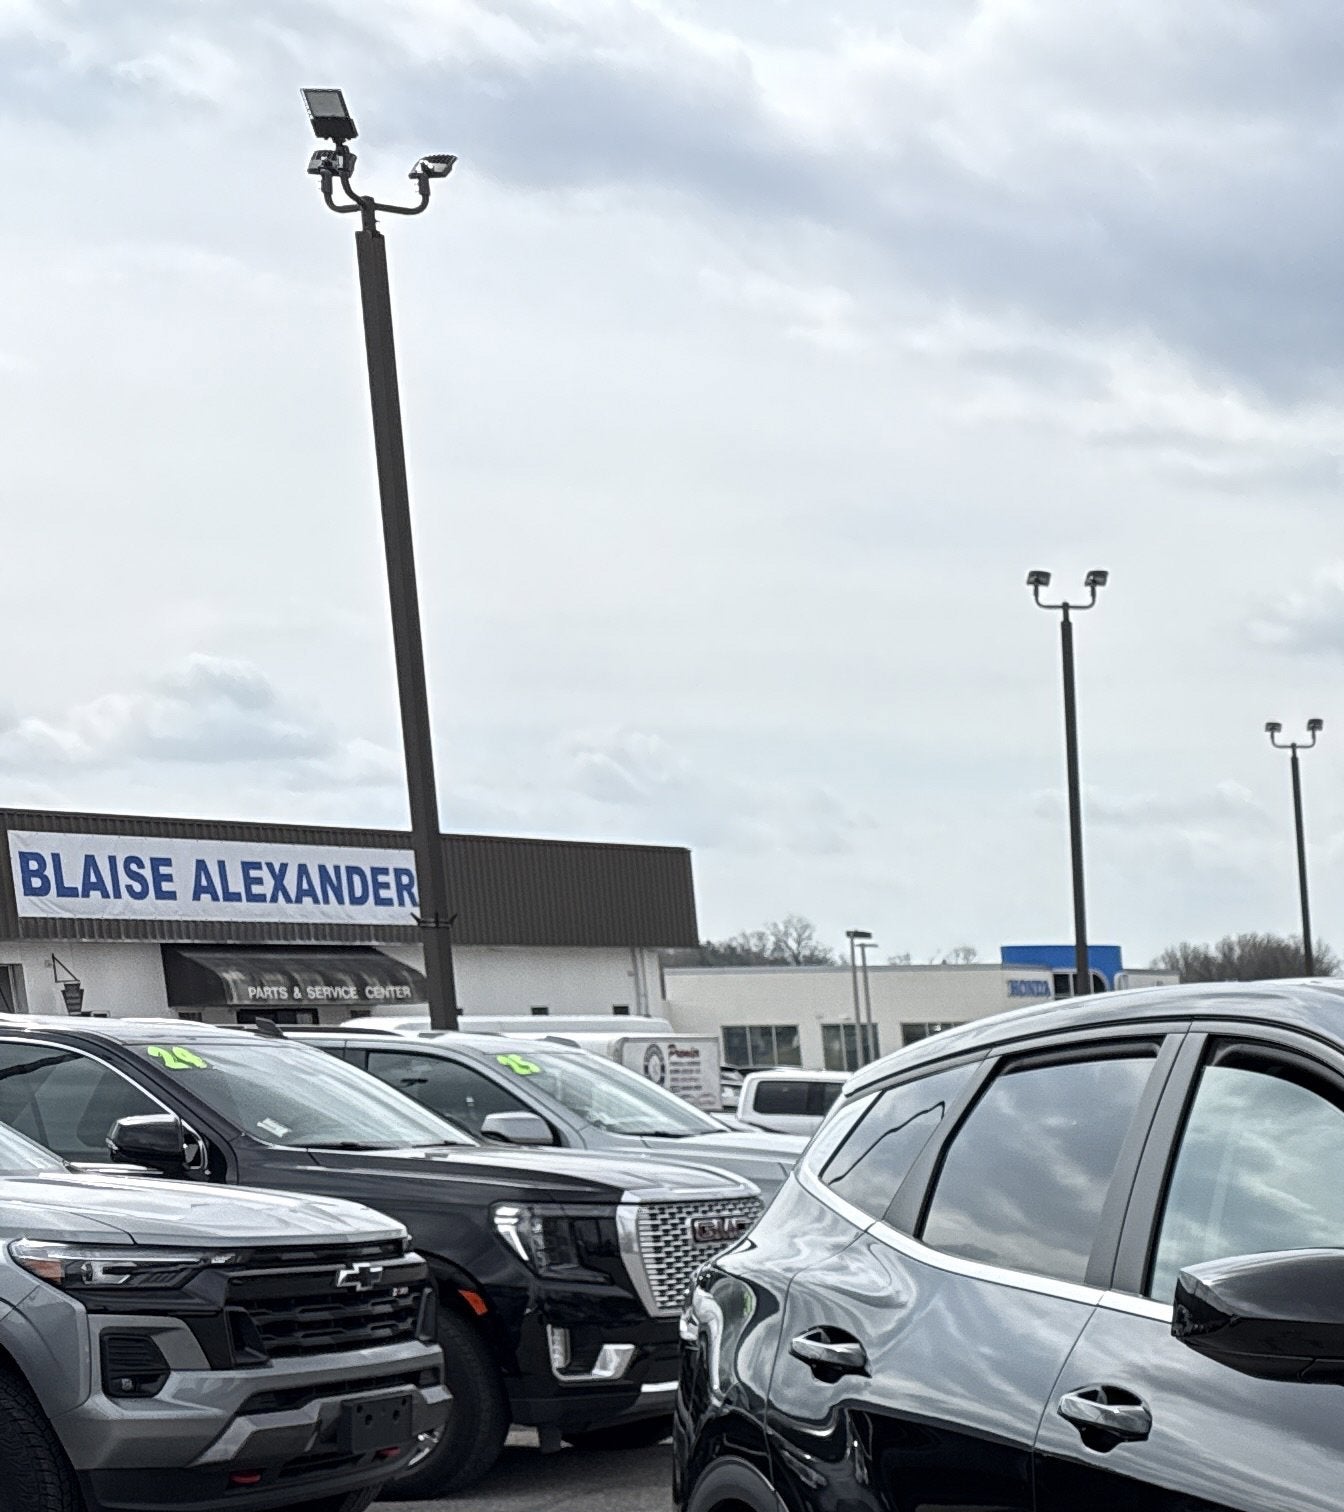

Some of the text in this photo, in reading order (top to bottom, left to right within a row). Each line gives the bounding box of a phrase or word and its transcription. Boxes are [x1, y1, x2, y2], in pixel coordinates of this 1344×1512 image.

[18, 851, 418, 907] BLAISE ALEXANDER
[248, 985, 411, 1000] PARTS & SERVICE CENTER
[147, 1045, 208, 1070] 24
